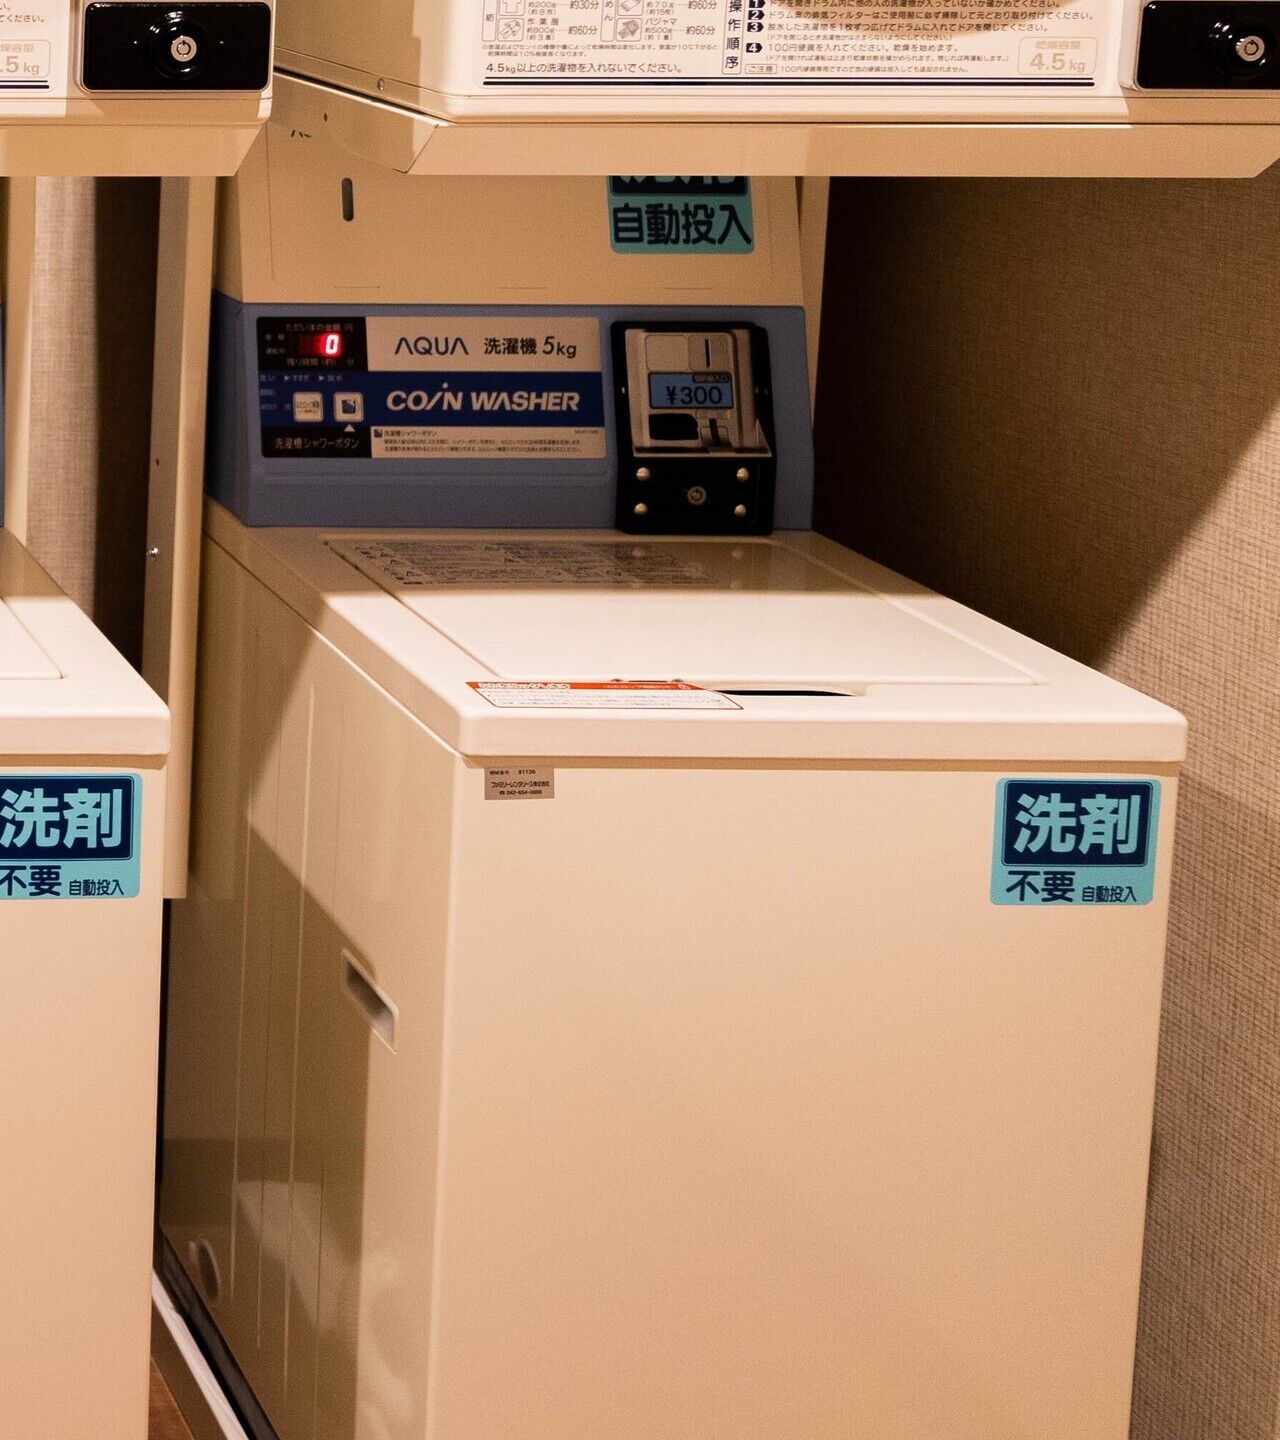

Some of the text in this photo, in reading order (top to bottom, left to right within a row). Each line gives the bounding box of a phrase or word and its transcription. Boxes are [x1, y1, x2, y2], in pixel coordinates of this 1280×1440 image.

[725, 0, 741, 69] 操作順序
[23, 62, 40, 76] kg
[1030, 53, 1085, 73] 4.5 kg
[612, 203, 751, 245] 自動投入
[325, 335, 339, 354] 0
[394, 336, 577, 358] AQUA 洗濯機 5kg
[471, 391, 580, 411] WASHER
[666, 385, 722, 404] ¥300
[0, 787, 123, 849] 洗剤
[1013, 792, 1141, 855] 洗剤
[69, 879, 124, 896] 自動投入
[1005, 871, 1137, 902] 不要 自動投入
